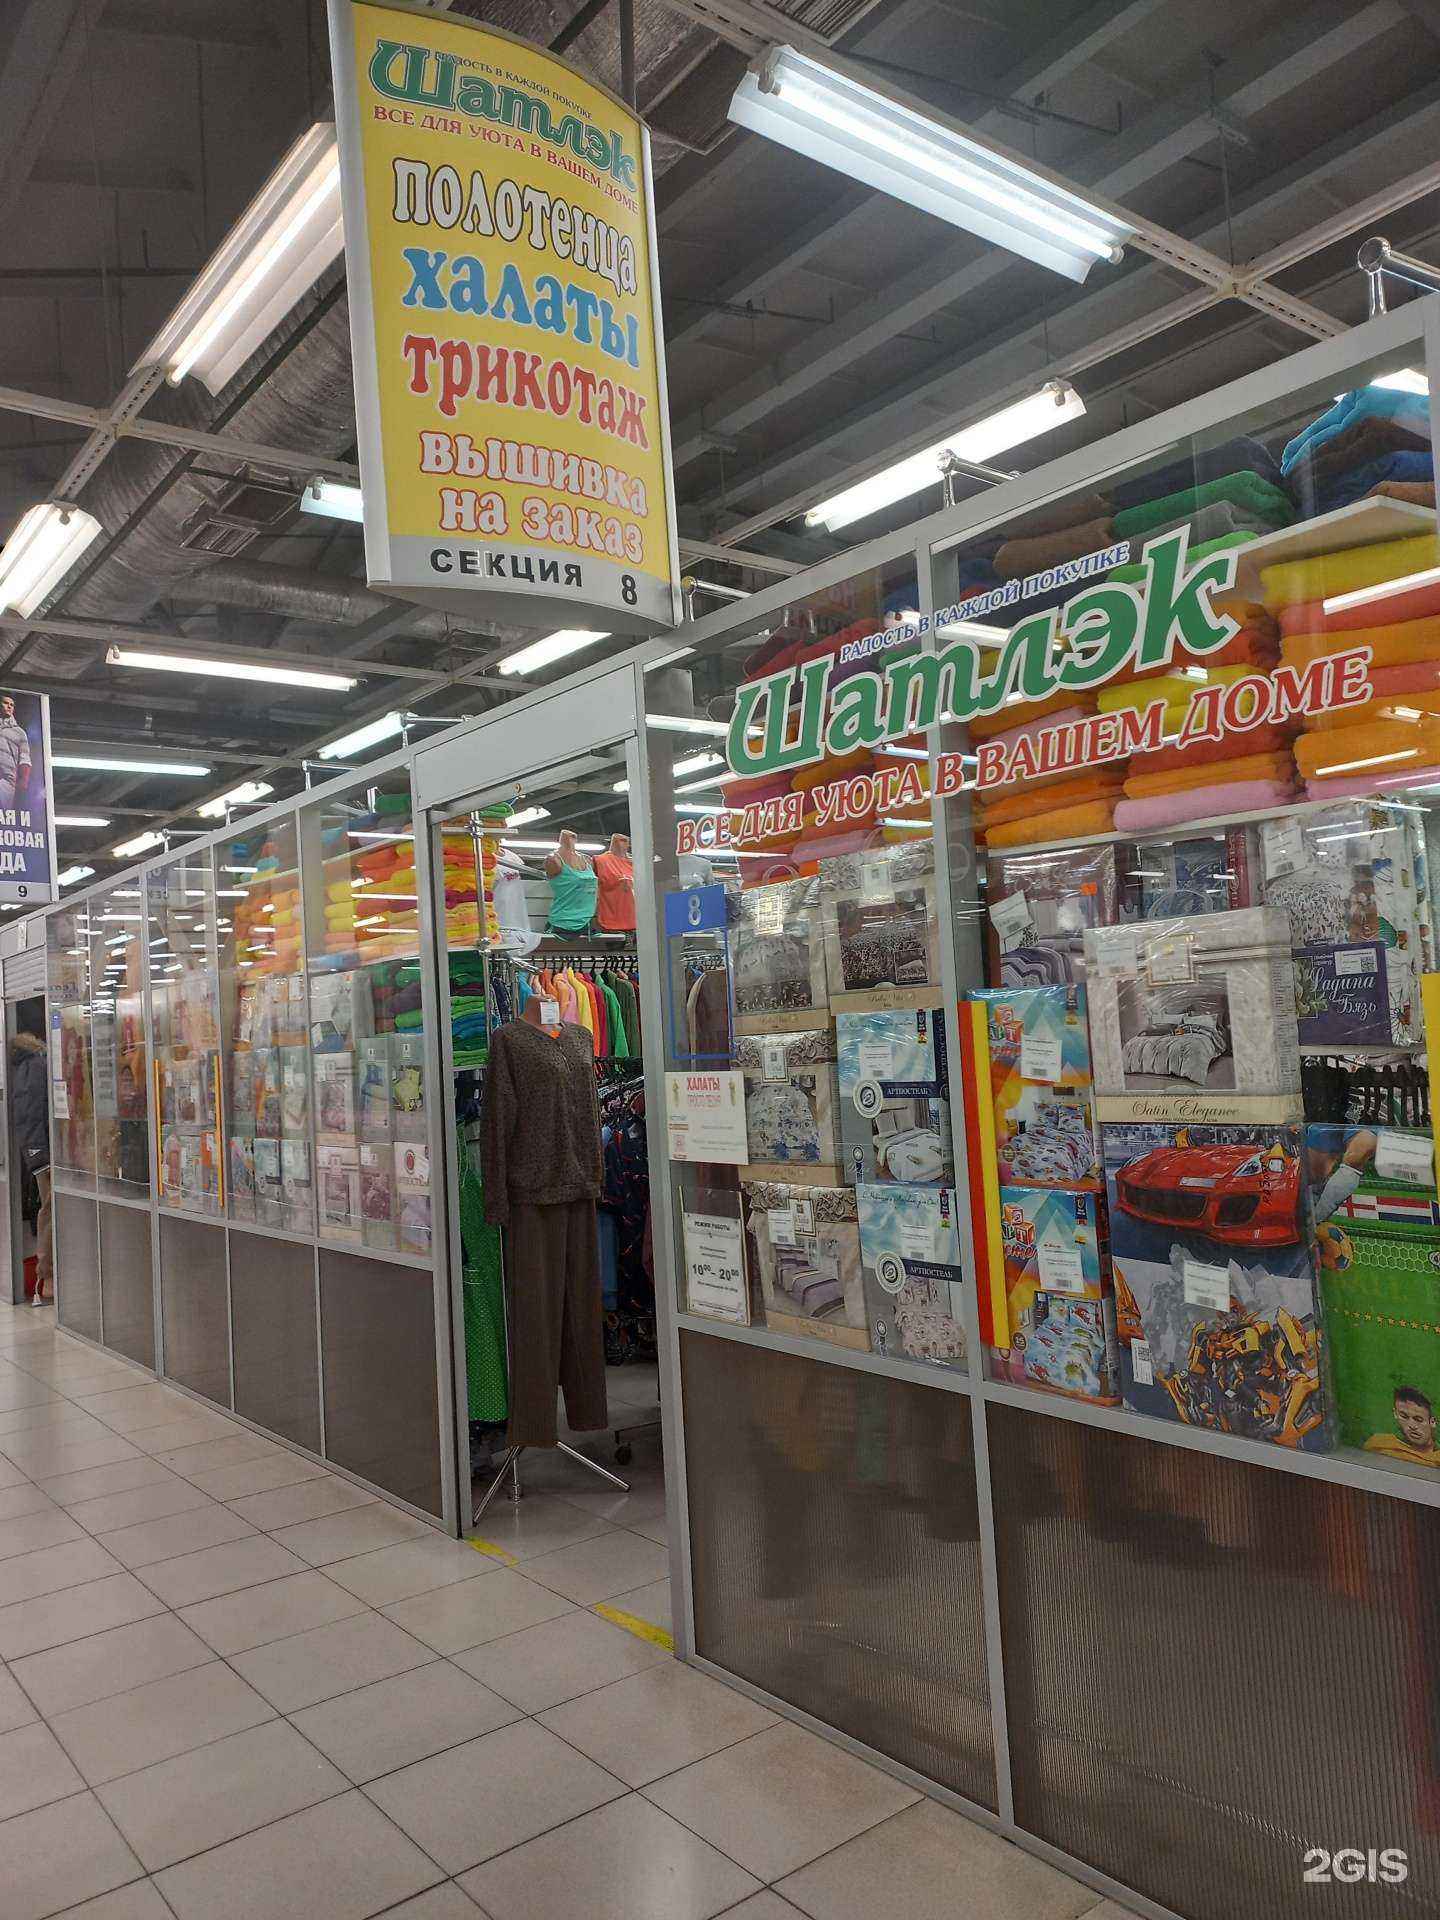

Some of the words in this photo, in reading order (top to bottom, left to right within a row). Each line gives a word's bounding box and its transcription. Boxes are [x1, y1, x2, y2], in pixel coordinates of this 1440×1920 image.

[369, 40, 637, 192] Шатлэк
[496, 68, 502, 77] В
[506, 72, 550, 96] КАЖДОЙ
[553, 91, 593, 120] ПОКУПКЕ
[374, 105, 414, 127] ВСЕ
[420, 115, 462, 136] ДЛЯ
[469, 123, 525, 152] УЮТА
[530, 143, 542, 158] В
[547, 150, 602, 189] ВАШЕМ
[604, 183, 639, 215] ДОМЕ
[430, 548, 583, 588] СЕКЦИЯ
[621, 574, 638, 606] 8
[840, 622, 916, 664] РАДОСТЬ
[917, 613, 930, 637] В
[934, 579, 1021, 630] КАЖДОЙ
[1021, 541, 1131, 599] ПОКУПКЕ
[726, 523, 1242, 779] Шатлэк
[676, 811, 733, 856] ВСЕ
[737, 792, 805, 845] ДЛЯ
[812, 762, 932, 827] УЮТА
[934, 752, 966, 797] В
[975, 699, 1167, 790] ВАШЕМ
[1177, 645, 1374, 750] ДОМЕ
[20, 811, 31, 827] И
[18, 885, 27, 898] 9
[687, 895, 701, 926] 8
[1133, 1101, 1168, 1116] Satin
[1174, 1099, 1240, 1120] Elegance
